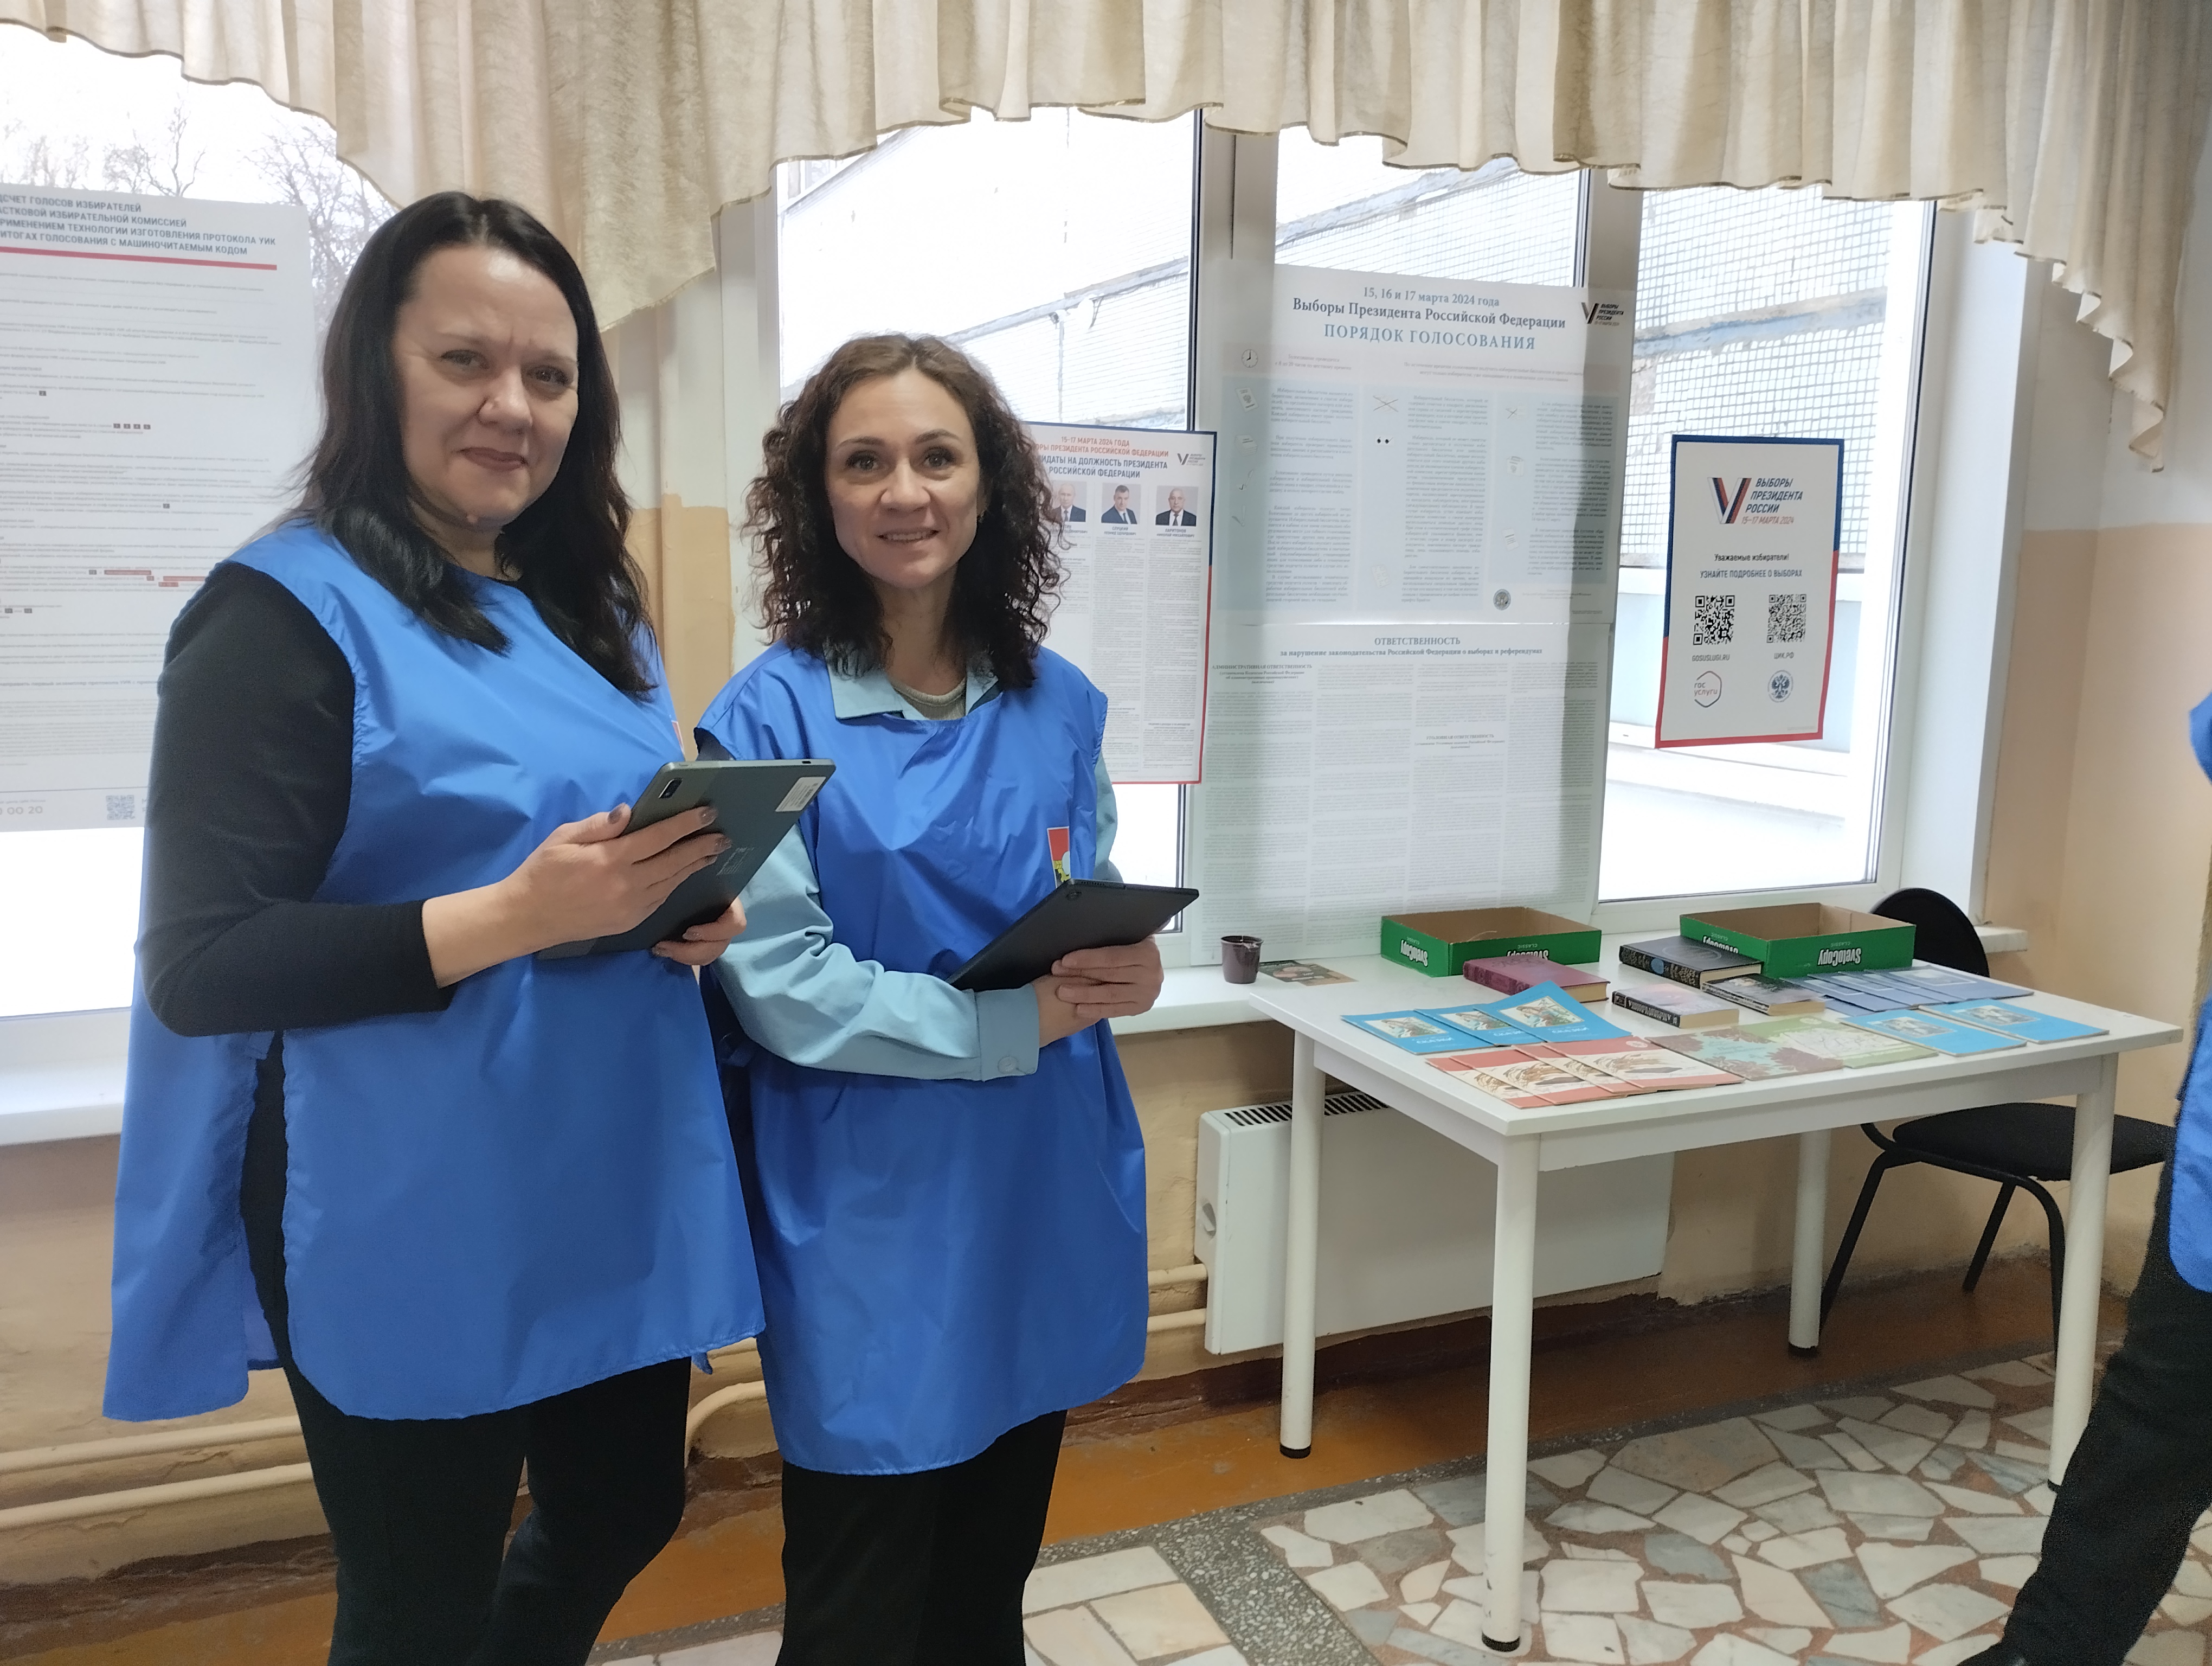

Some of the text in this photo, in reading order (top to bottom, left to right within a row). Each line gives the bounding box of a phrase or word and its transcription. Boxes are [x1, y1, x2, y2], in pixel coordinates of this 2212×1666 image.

[30, 196, 73, 207] ГОЛОСОВ
[76, 200, 141, 213] ИЗБИРАТЕЛЕЙ
[50, 210, 128, 223] ИЗБИРАТЕЛЬНОЙ
[132, 216, 187, 227] КОМИССИЕЙ
[68, 223, 127, 235] ТЕХНОЛОГИИ
[131, 228, 200, 240] ИЗГОТОВЛЕНИЯ
[203, 233, 256, 244] ПРОТОКОЛА
[259, 237, 275, 245] УИК
[0, 230, 37, 241] ИТОГАХ
[40, 233, 108, 245] ГОЛОСОВАНИЯ
[119, 239, 213, 252] МАШИНОЧИТАЕМЫМ
[215, 246, 247, 255] КОДОМ
[1364, 287, 1500, 307] 15, 16 и 17 марта 2024 года
[1293, 297, 1566, 330] Выборы Президента Российской Федерации
[1324, 324, 1535, 350] ПОРЯДОК ГОЛОСОВАНИЯ
[1050, 444, 1089, 453] ПРЕЗИДЕНТА
[1090, 446, 1130, 455] РОССИЙСКОЙ
[1131, 448, 1169, 458] ФЕДЕРАЦИИ
[1078, 457, 1122, 466] ДОЛЖНОСТЬ
[1123, 459, 1168, 469] ПРЕЗИДЕНТА
[1049, 466, 1140, 479] РОССИЙСКОЙ ФЕДЕРАЦИИ
[1756, 478, 1793, 488] ВЫБОРЫ
[1750, 491, 1803, 502] ПРЕЗИДЕНТА
[1745, 504, 1780, 514] РОССИИ
[1759, 516, 1779, 524] МАРТА
[1780, 516, 1794, 524] 2024
[1714, 553, 1789, 562] Уважаемые избиратели!
[1700, 568, 1728, 579] УЗНАЙТЕ
[1729, 569, 1766, 579] ПОДРОБНЕЕ
[1773, 569, 1802, 578] ВЫБОРАХ
[1374, 637, 1461, 646] ОТВЕТСТВЕННОСТЬ
[1500, 648, 1542, 656] референдумах
[28, 806, 43, 815] 20
[1400, 939, 1428, 967] SvetoCopy
[1818, 948, 1861, 966] SvetoCopy
